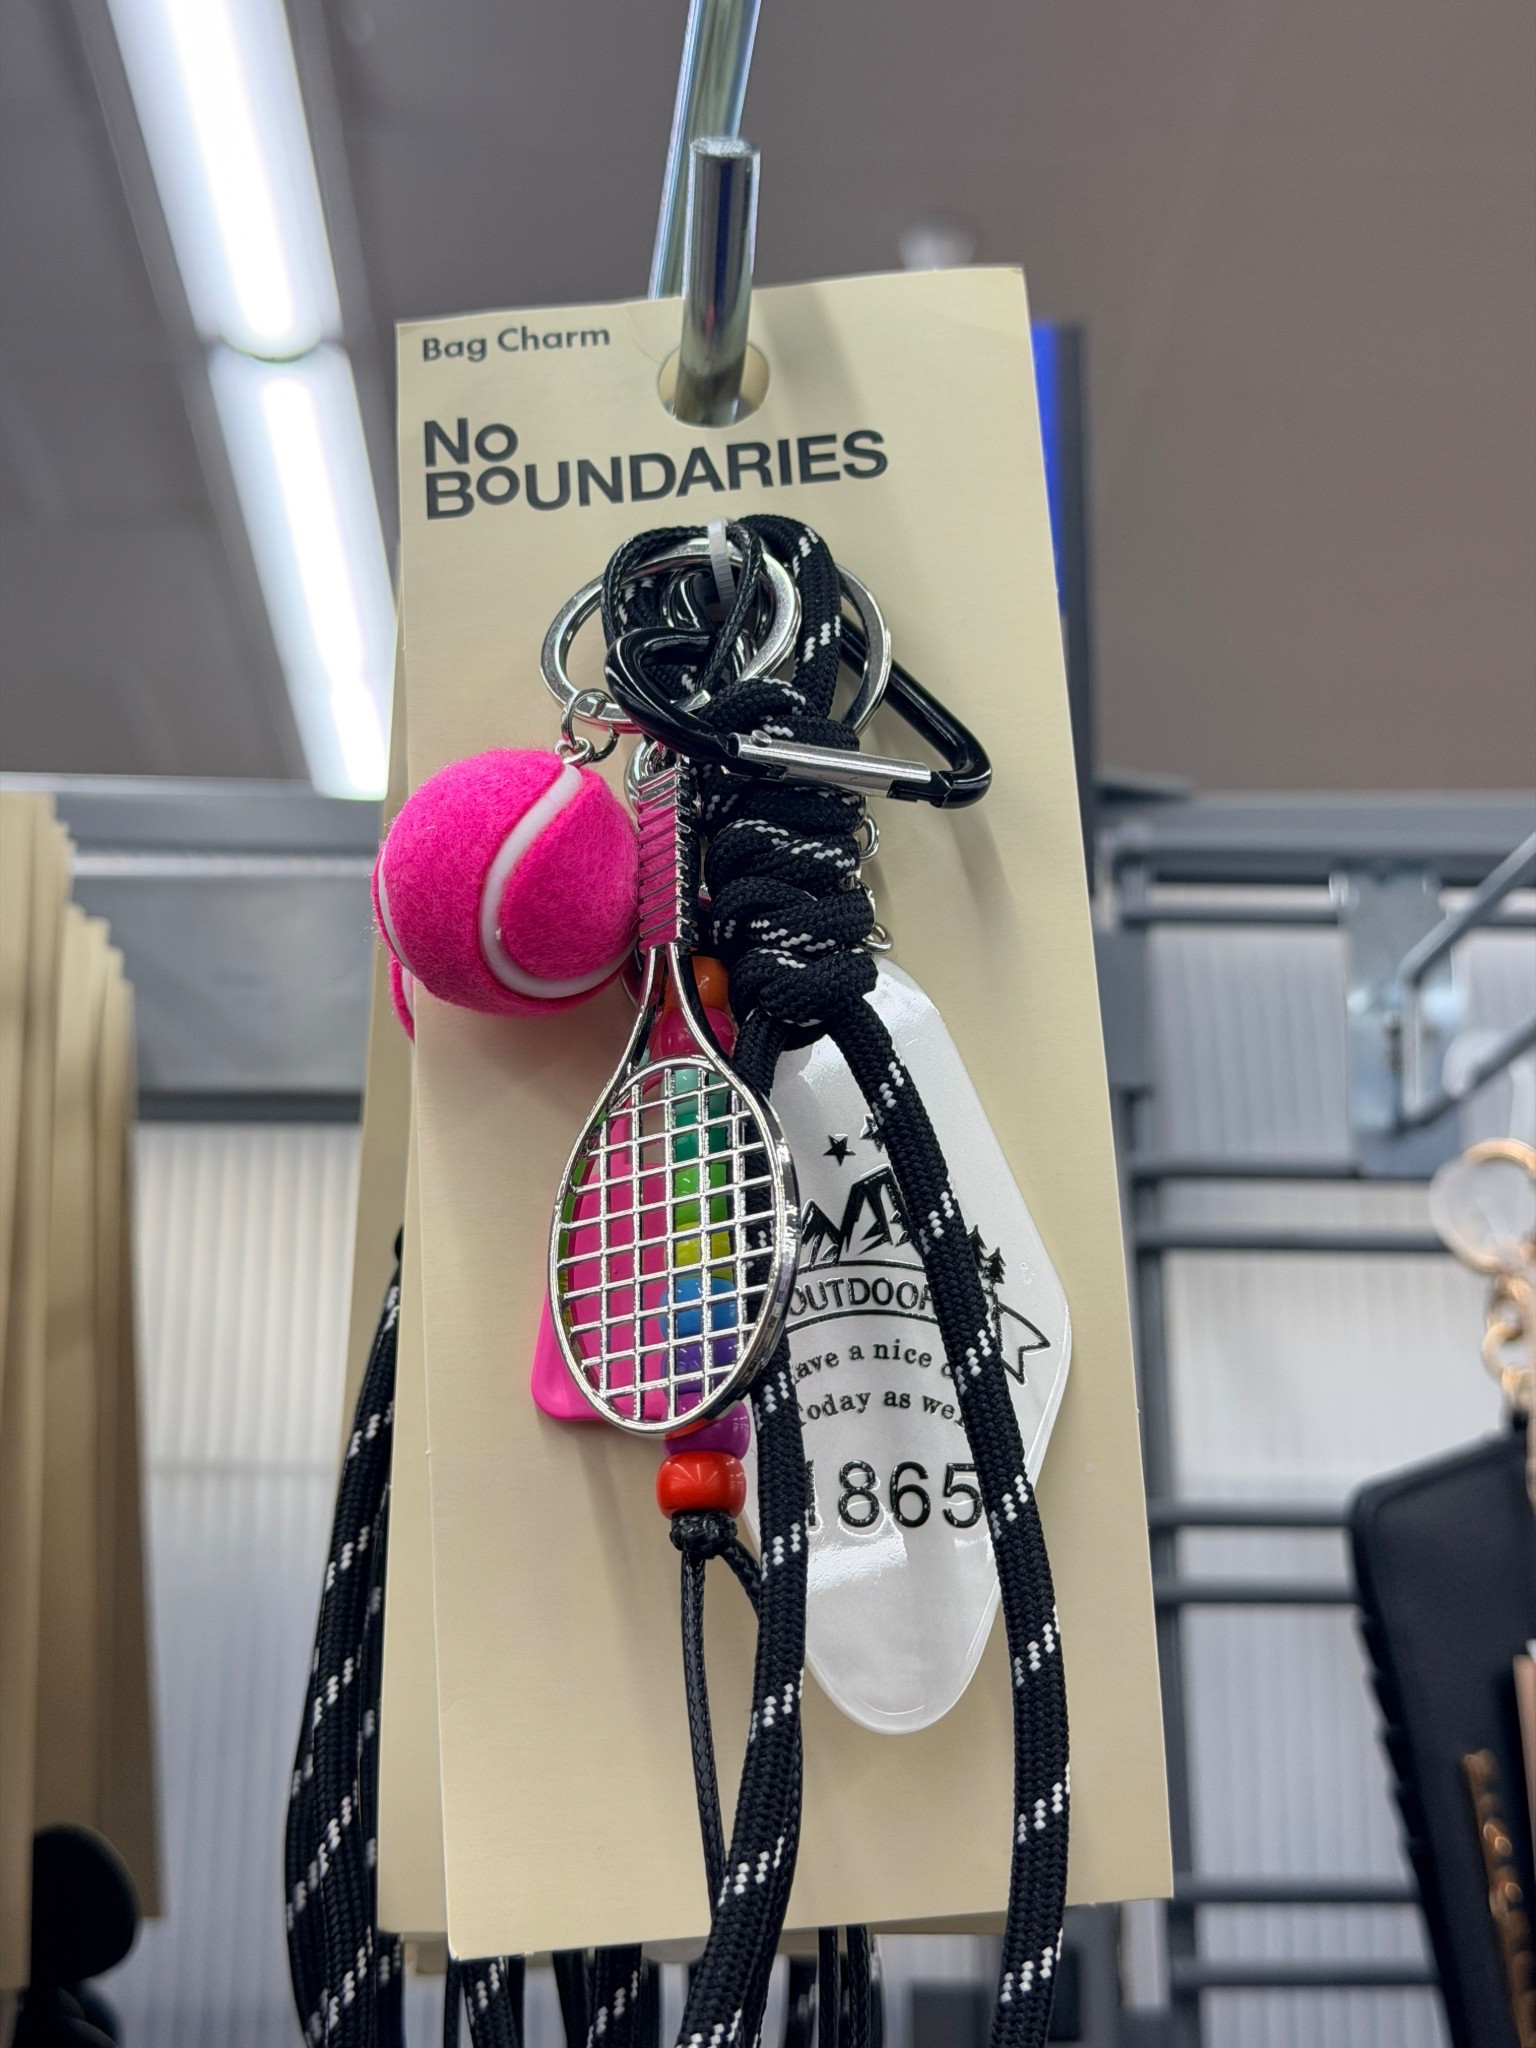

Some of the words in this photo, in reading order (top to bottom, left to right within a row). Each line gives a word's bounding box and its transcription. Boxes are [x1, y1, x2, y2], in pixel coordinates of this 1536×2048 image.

[422, 336, 488, 363] Bag
[497, 325, 611, 353] Charm
[791, 1351, 839, 1384] ave
[848, 1345, 865, 1361] a
[873, 1338, 933, 1369] nice
[883, 1390, 911, 1409] as
